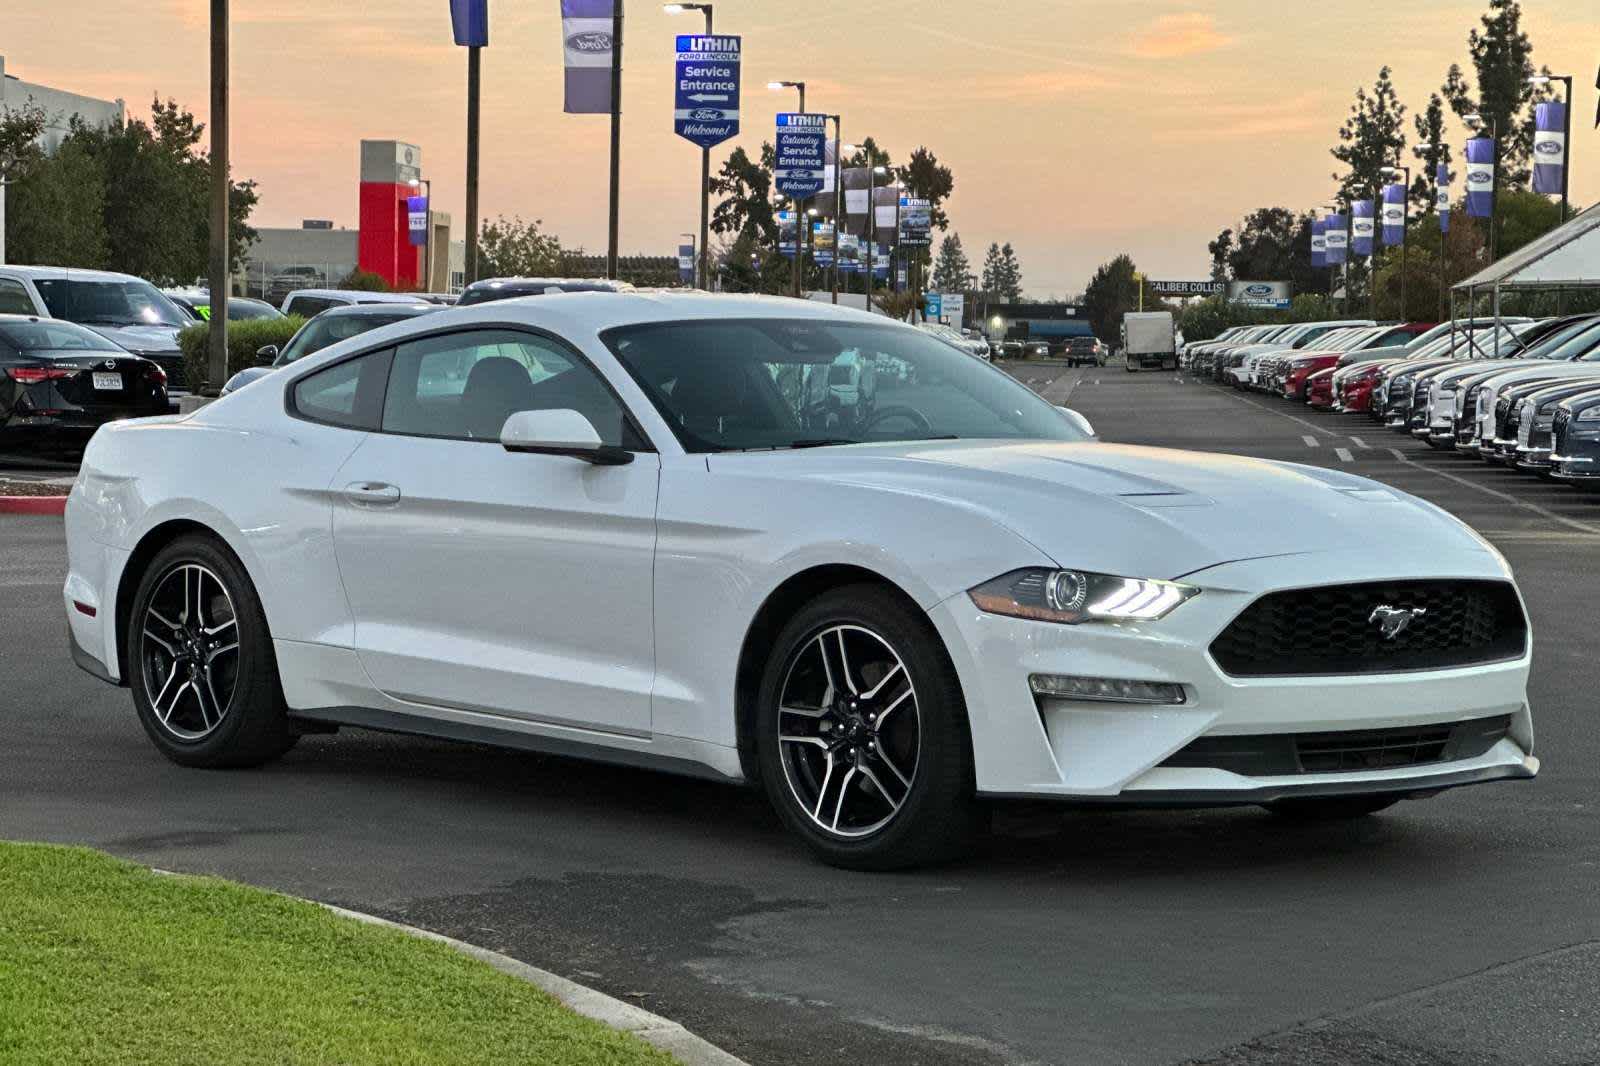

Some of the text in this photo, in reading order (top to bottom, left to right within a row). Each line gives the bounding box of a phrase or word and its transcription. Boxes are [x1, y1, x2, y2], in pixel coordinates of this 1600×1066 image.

[691, 38, 739, 51] LITHIA
[685, 66, 730, 77] Service
[680, 80, 735, 91] Entrance
[695, 110, 718, 119] Ford
[788, 115, 825, 126] LITHIA
[684, 123, 730, 136] Welcome!
[781, 135, 819, 148] Saturday
[783, 147, 818, 155] Service
[780, 157, 821, 166] Entrance
